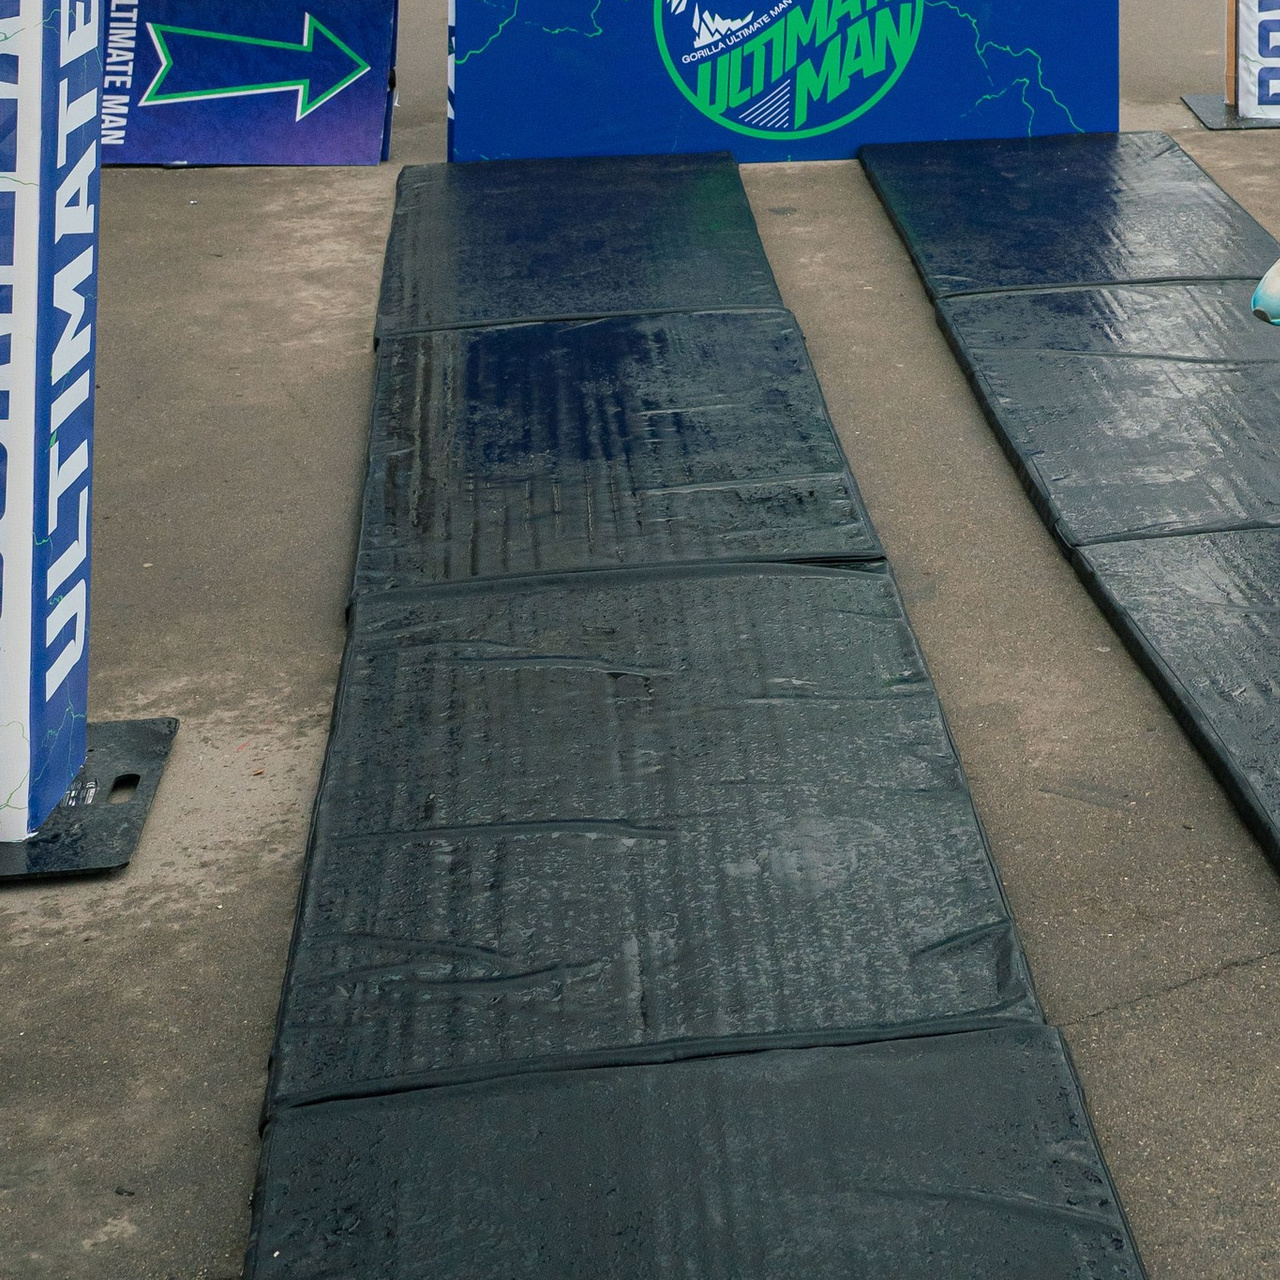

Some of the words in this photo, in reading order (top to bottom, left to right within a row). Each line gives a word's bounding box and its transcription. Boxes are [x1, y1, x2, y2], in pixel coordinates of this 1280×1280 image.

[682, 41, 726, 64] GORILLA
[725, 12, 771, 45] ULTIMATE
[794, 2, 913, 130] MAN
[101, 95, 130, 145] MAN
